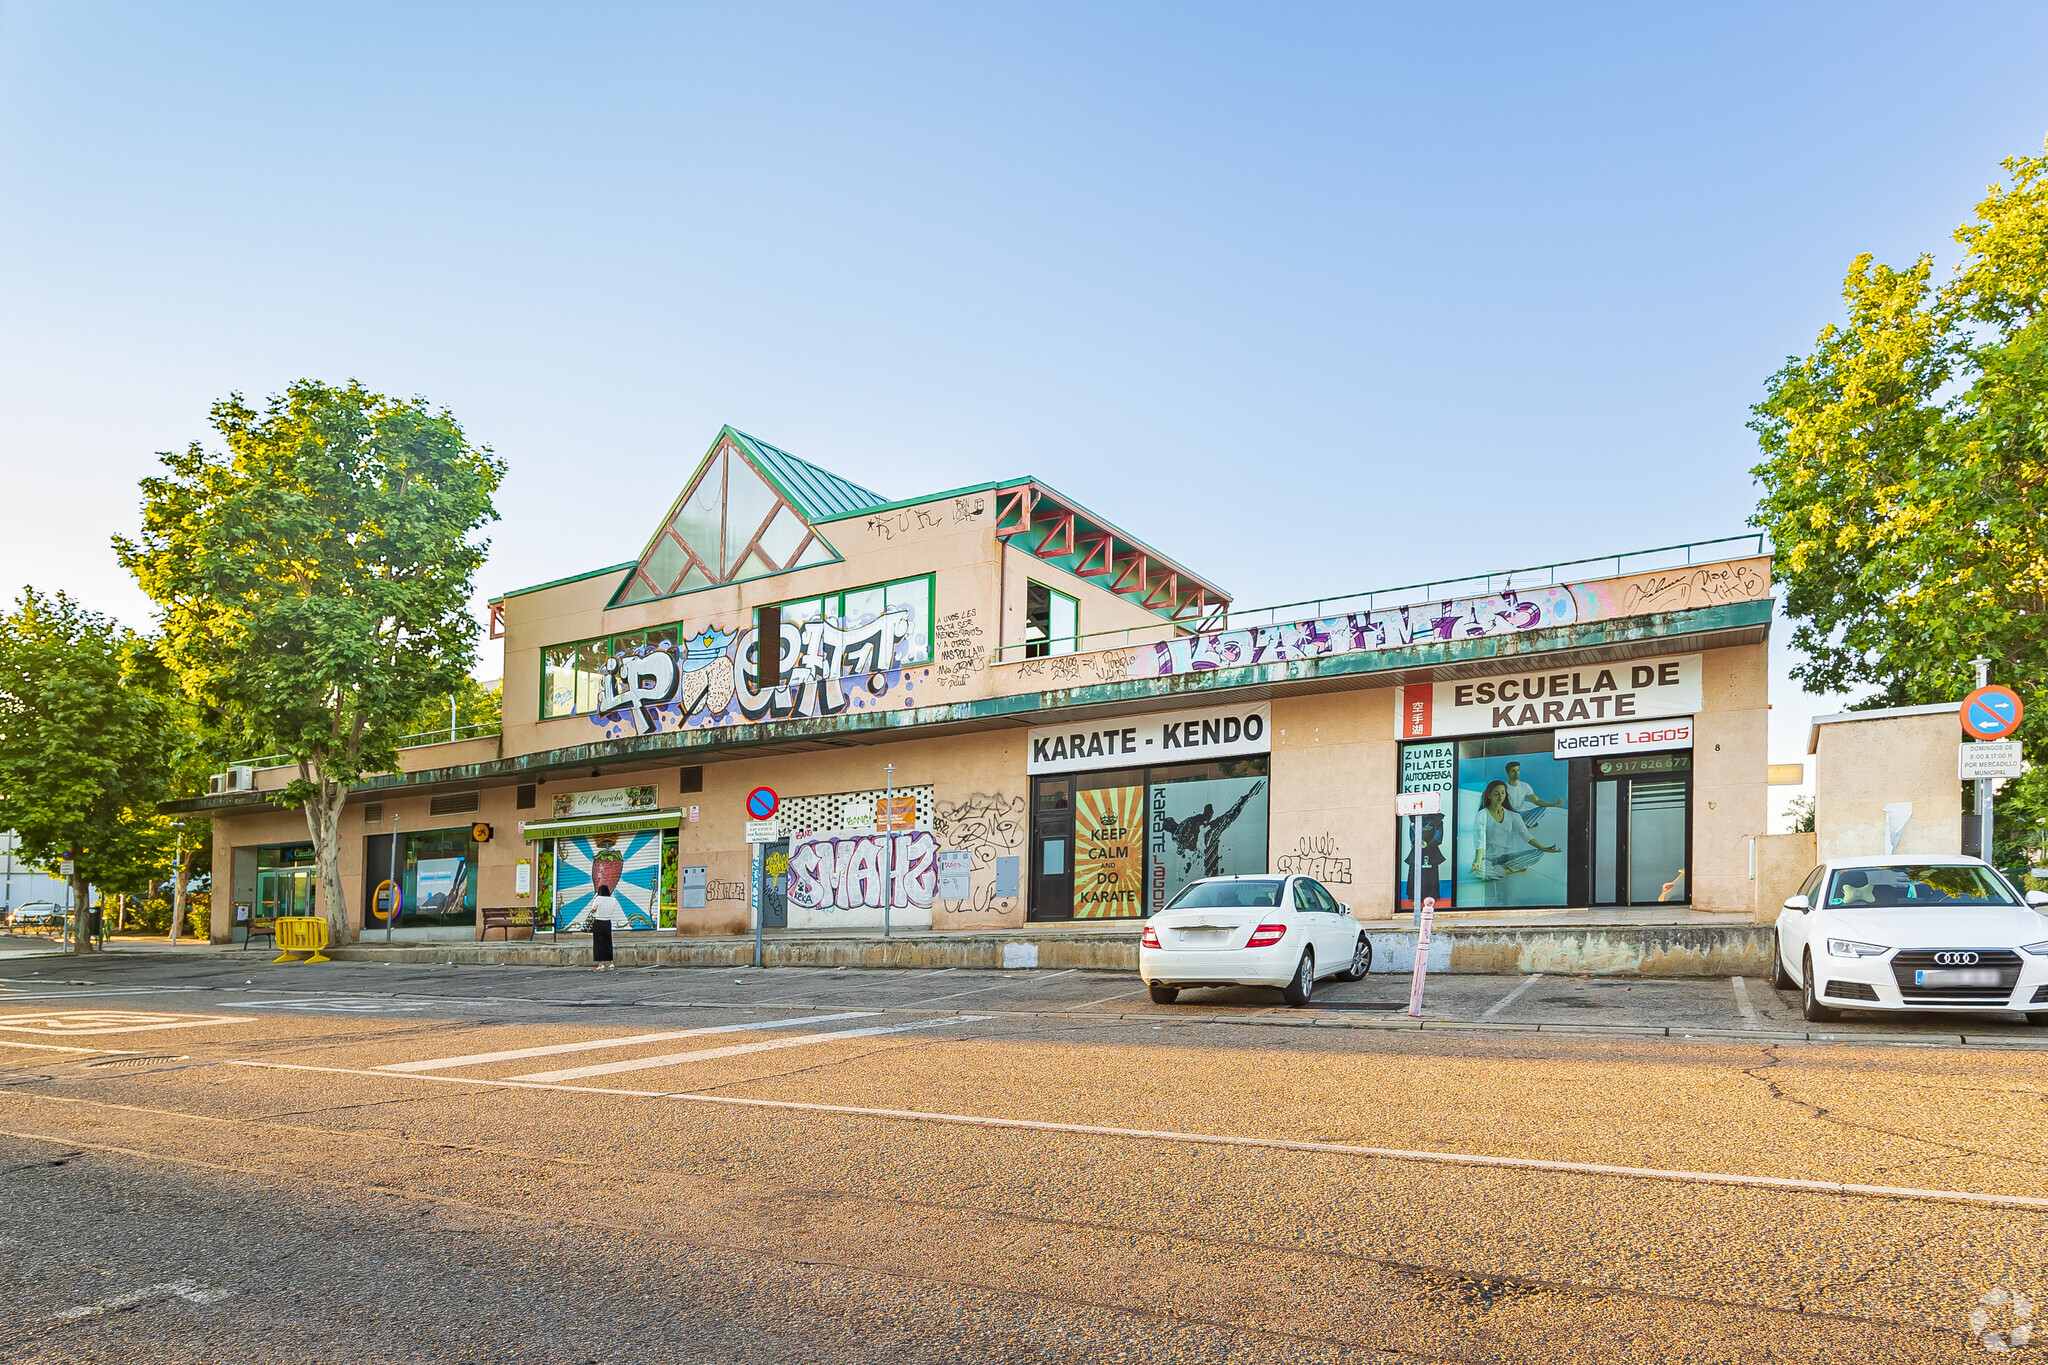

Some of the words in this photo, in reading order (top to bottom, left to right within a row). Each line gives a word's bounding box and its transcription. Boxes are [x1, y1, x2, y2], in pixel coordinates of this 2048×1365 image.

[961, 608, 977, 619] LES
[957, 619, 973, 629] SER
[950, 638, 972, 648] OTROS
[1454, 669, 1618, 707] ESCUELA
[1631, 661, 1680, 689] DE
[1492, 693, 1637, 728] KARATE
[1033, 727, 1137, 763] KARATE
[1162, 713, 1264, 749] KENDO
[1405, 748, 1452, 760] ZUMBA
[1714, 744, 1721, 752] 8
[1405, 759, 1452, 771] PILATES
[1615, 761, 1637, 771] 917
[1640, 759, 1663, 770] 826
[1665, 757, 1688, 768] 677
[1405, 770, 1452, 782] AUTODEFENSA
[1404, 782, 1452, 794] KENDO
[578, 795, 589, 806] El
[549, 828, 565, 836] FRUTA
[565, 827, 575, 835] MAS
[576, 826, 592, 834] DULCE
[596, 825, 602, 833] LA
[602, 823, 627, 832] VERDURA
[628, 822, 639, 830] MAS
[639, 820, 659, 830] FRESCA
[1091, 828, 1127, 841] KEEP
[1088, 846, 1128, 859] CALM
[1097, 872, 1119, 884] DO
[1080, 890, 1135, 903] KARATE
